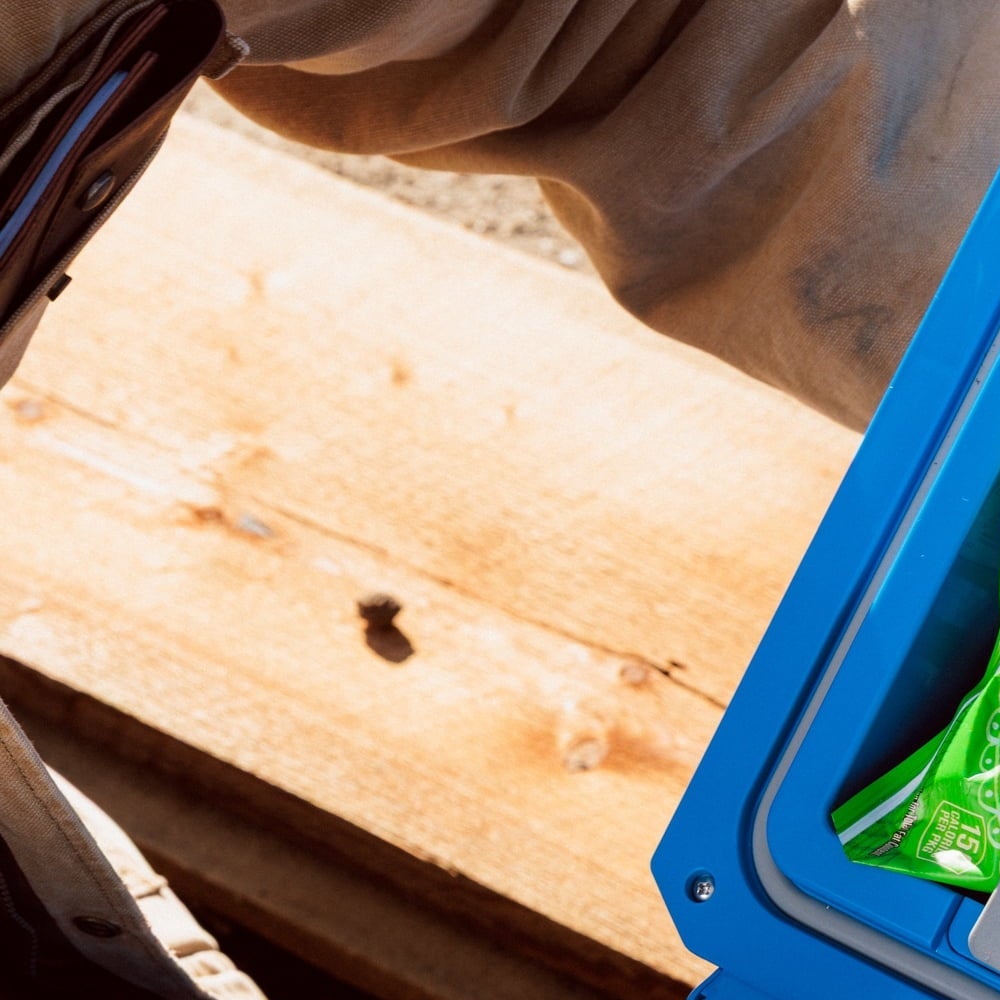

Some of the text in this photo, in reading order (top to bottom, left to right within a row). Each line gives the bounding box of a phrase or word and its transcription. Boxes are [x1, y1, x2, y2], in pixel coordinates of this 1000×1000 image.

[922, 809, 950, 855] PER PKG
[931, 810, 960, 859] CALORI
[957, 824, 981, 860] 15
